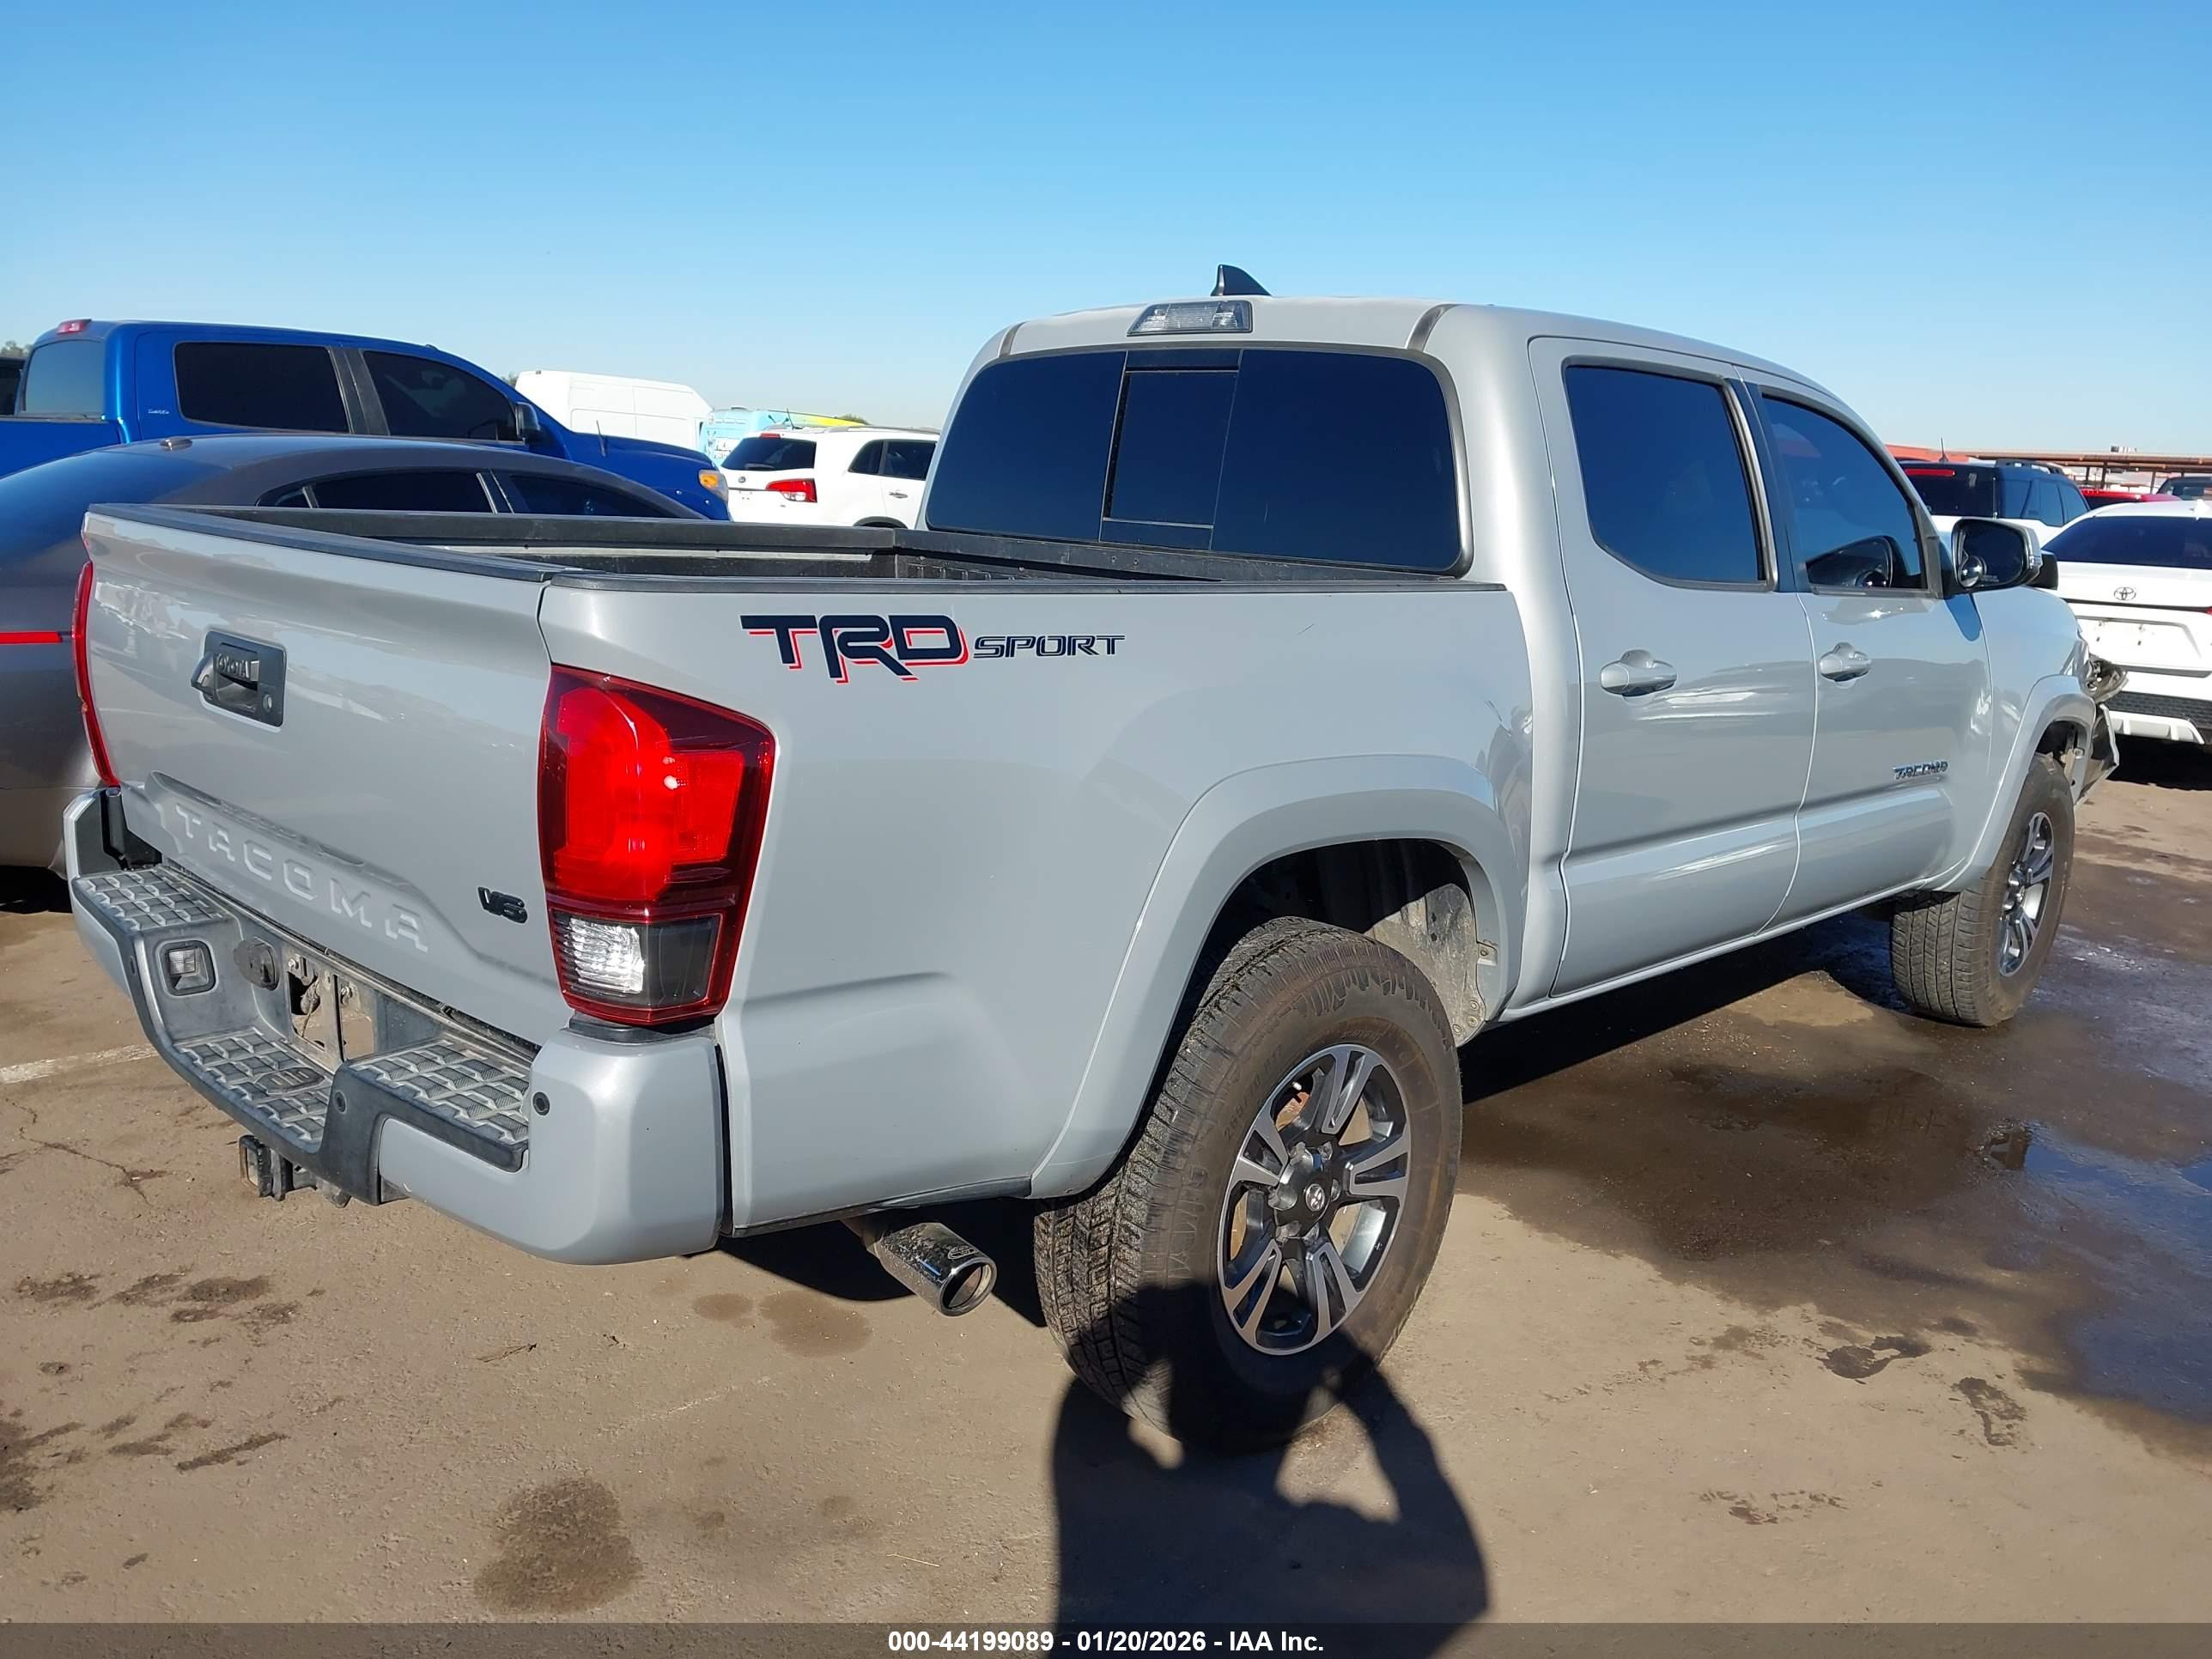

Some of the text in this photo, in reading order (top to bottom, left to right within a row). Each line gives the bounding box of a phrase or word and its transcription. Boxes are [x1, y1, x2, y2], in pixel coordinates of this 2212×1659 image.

[740, 613, 1126, 684] TRD SPORT
[174, 802, 429, 952] TACOMA
[477, 886, 529, 924] V6
